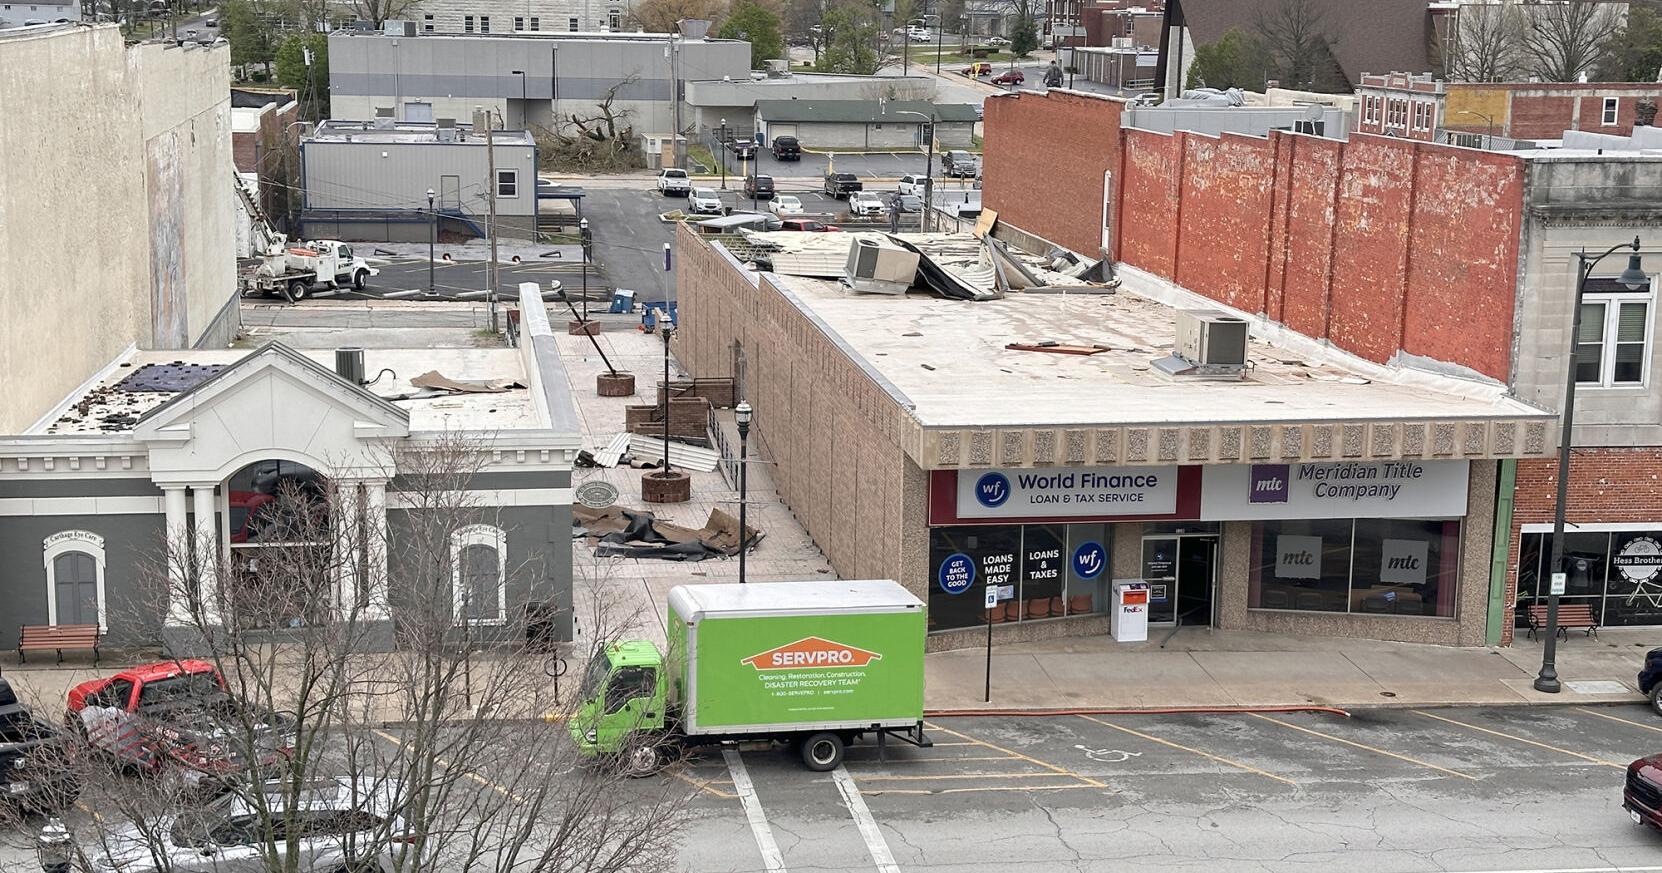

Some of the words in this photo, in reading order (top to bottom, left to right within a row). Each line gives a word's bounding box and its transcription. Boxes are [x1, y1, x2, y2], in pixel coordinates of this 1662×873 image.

[1299, 463, 1377, 481] Meridian
[1383, 463, 1423, 479] Title
[1018, 474, 1075, 490] World
[1081, 473, 1157, 489] Finance
[1256, 477, 1283, 492] mtc
[982, 481, 1002, 496] wf
[1315, 483, 1401, 501] Company
[1030, 494, 1060, 504] LOAN
[1063, 494, 1071, 504] &
[1075, 494, 1095, 504] TAX
[1098, 493, 1144, 503] SERVICE
[983, 554, 1013, 565] LOANS
[1029, 550, 1059, 560] LOANS
[1079, 550, 1098, 567] wf
[1282, 550, 1314, 565] mtc
[1613, 556, 1632, 564] Hess
[1040, 561, 1047, 569] &
[1387, 554, 1420, 570] mtc
[984, 564, 1011, 574] MADE
[1029, 569, 1058, 580] TAXES
[956, 572, 968, 580] THE
[986, 575, 1009, 584] EASY
[764, 681, 799, 689] DISASTER
[800, 679, 836, 687] RECOVERY
